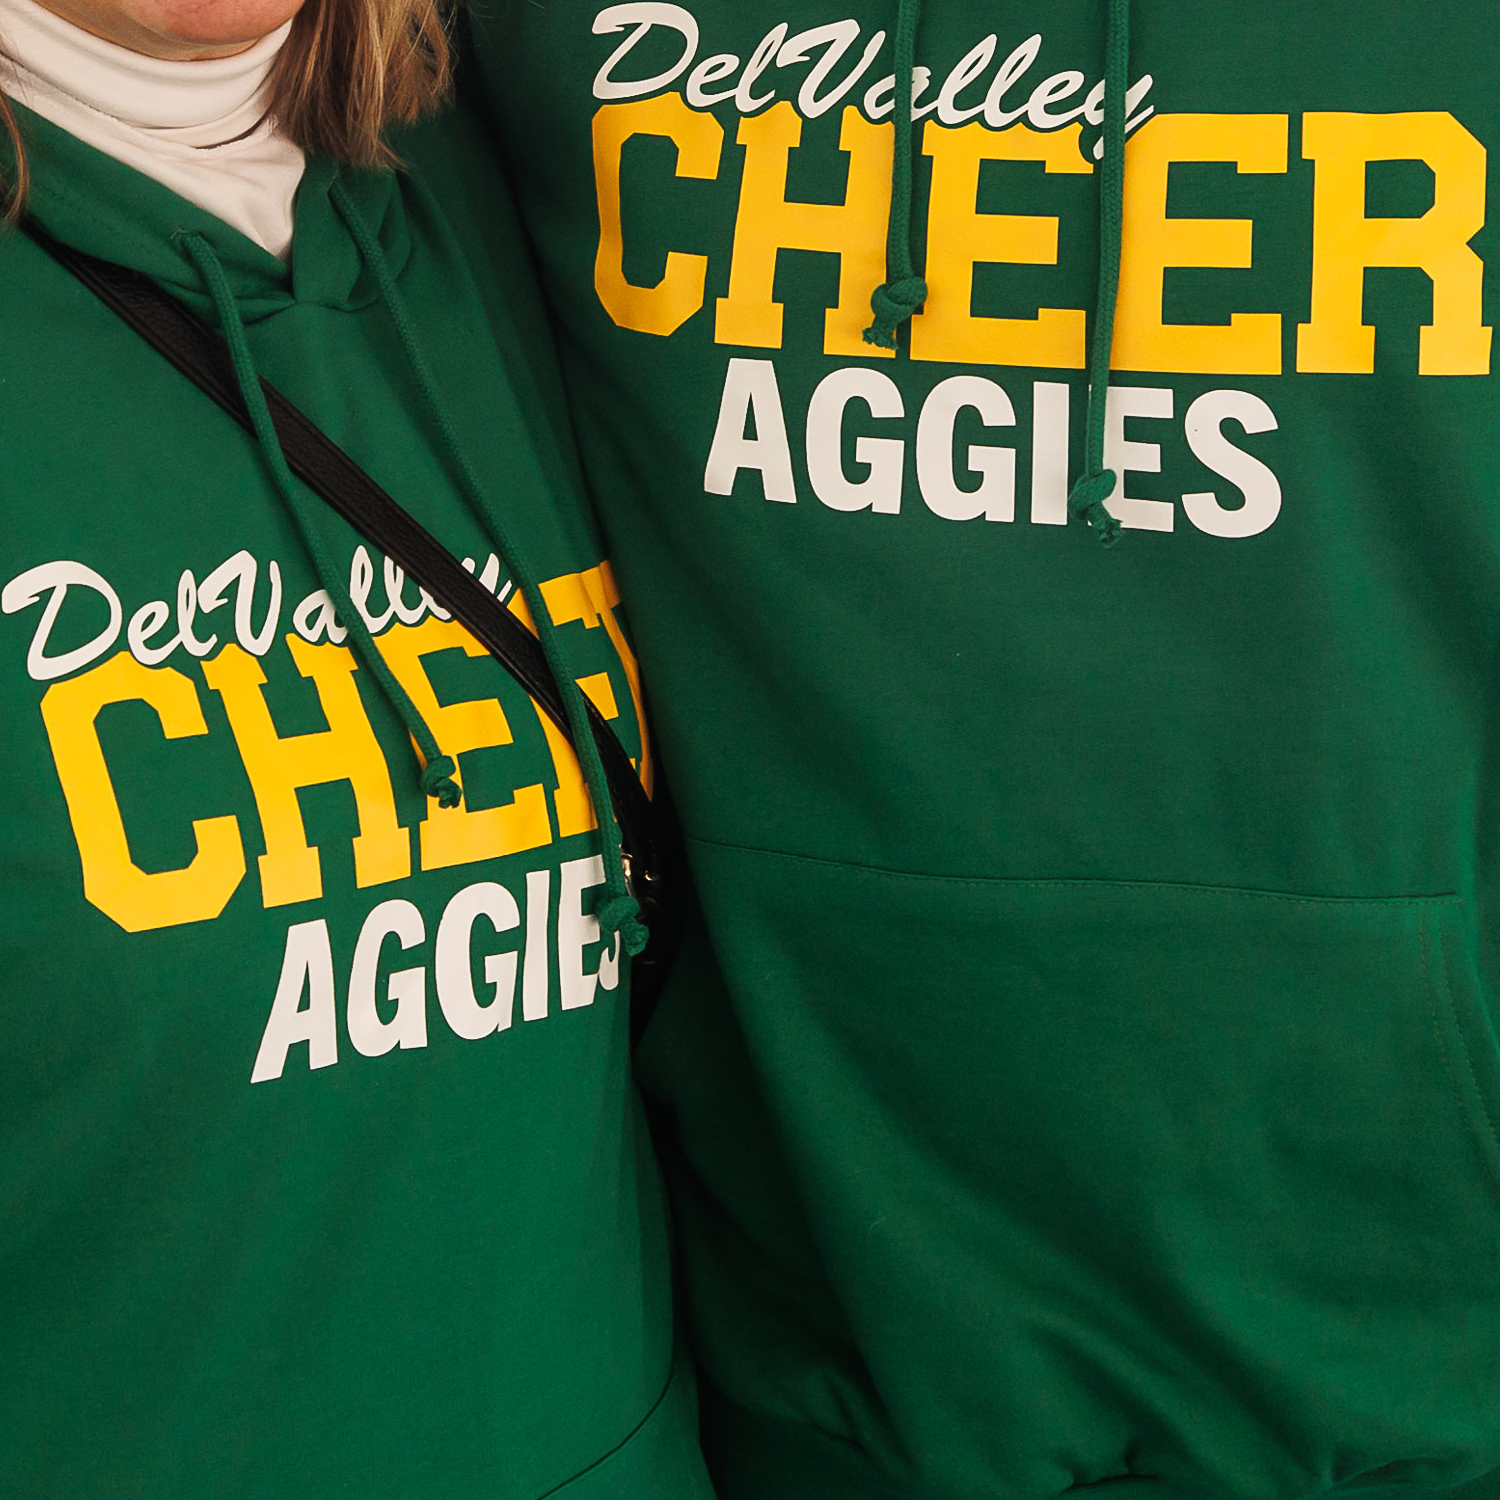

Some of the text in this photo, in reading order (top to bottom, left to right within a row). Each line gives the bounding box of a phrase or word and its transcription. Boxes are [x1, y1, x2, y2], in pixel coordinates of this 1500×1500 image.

[592, 2, 1154, 160] DelValley
[592, 92, 1493, 375] CHEER
[704, 357, 1283, 538] AGGIES
[40, 560, 654, 933] CHEE
